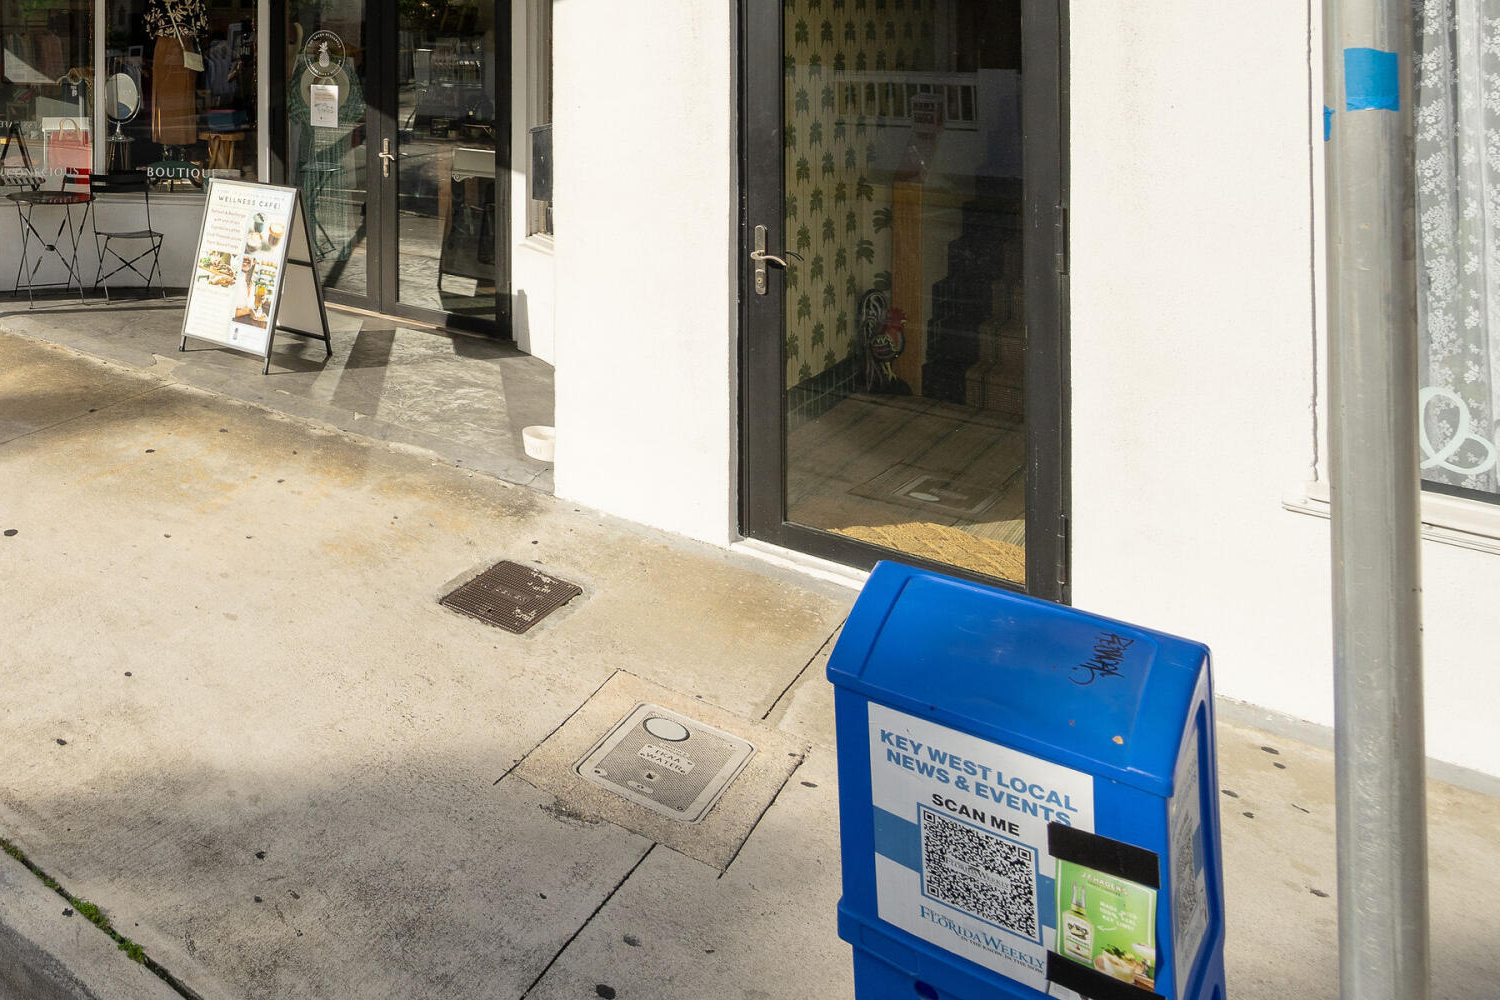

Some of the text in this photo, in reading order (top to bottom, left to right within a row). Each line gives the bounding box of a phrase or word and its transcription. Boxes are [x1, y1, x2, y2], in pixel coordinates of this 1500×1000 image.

[218, 195, 256, 207] WELLNESS
[880, 729, 1078, 813] KEY WEST LOCAL
[887, 749, 1072, 827] NEWS & EVENTS
[932, 793, 1021, 837] SCAN ME
[920, 905, 1045, 969] FLORIDA WEEKLY
